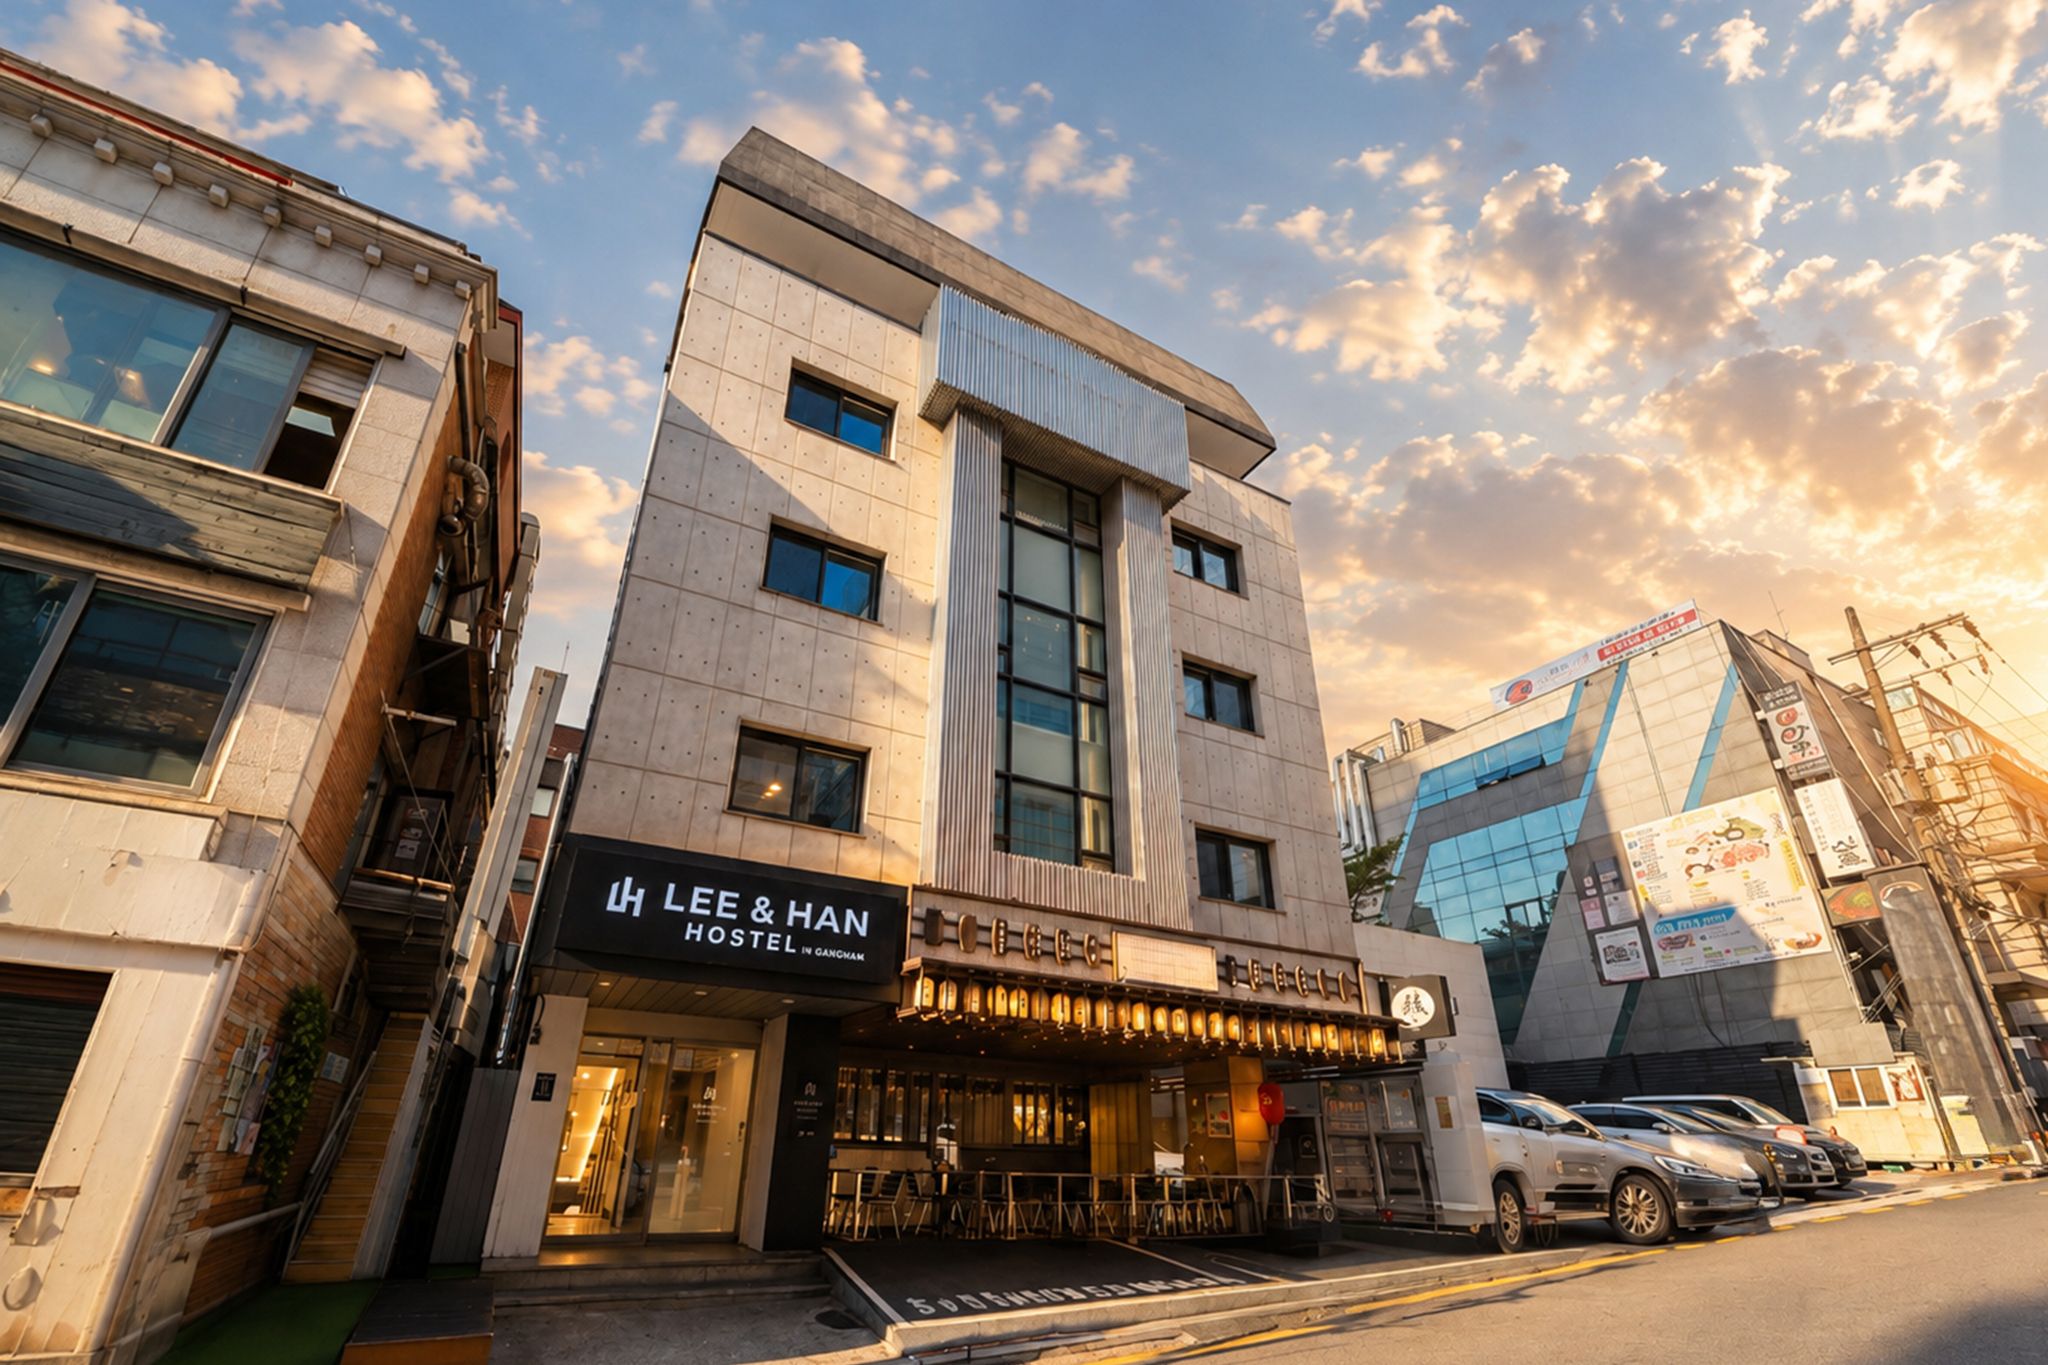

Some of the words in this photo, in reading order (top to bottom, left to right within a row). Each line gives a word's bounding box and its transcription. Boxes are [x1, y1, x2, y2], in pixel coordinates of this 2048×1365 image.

[663, 882, 740, 920] LEE
[750, 895, 775, 925] &
[786, 899, 869, 937] HAN
[684, 922, 797, 953] HOSTEL
[801, 946, 812, 955] IN
